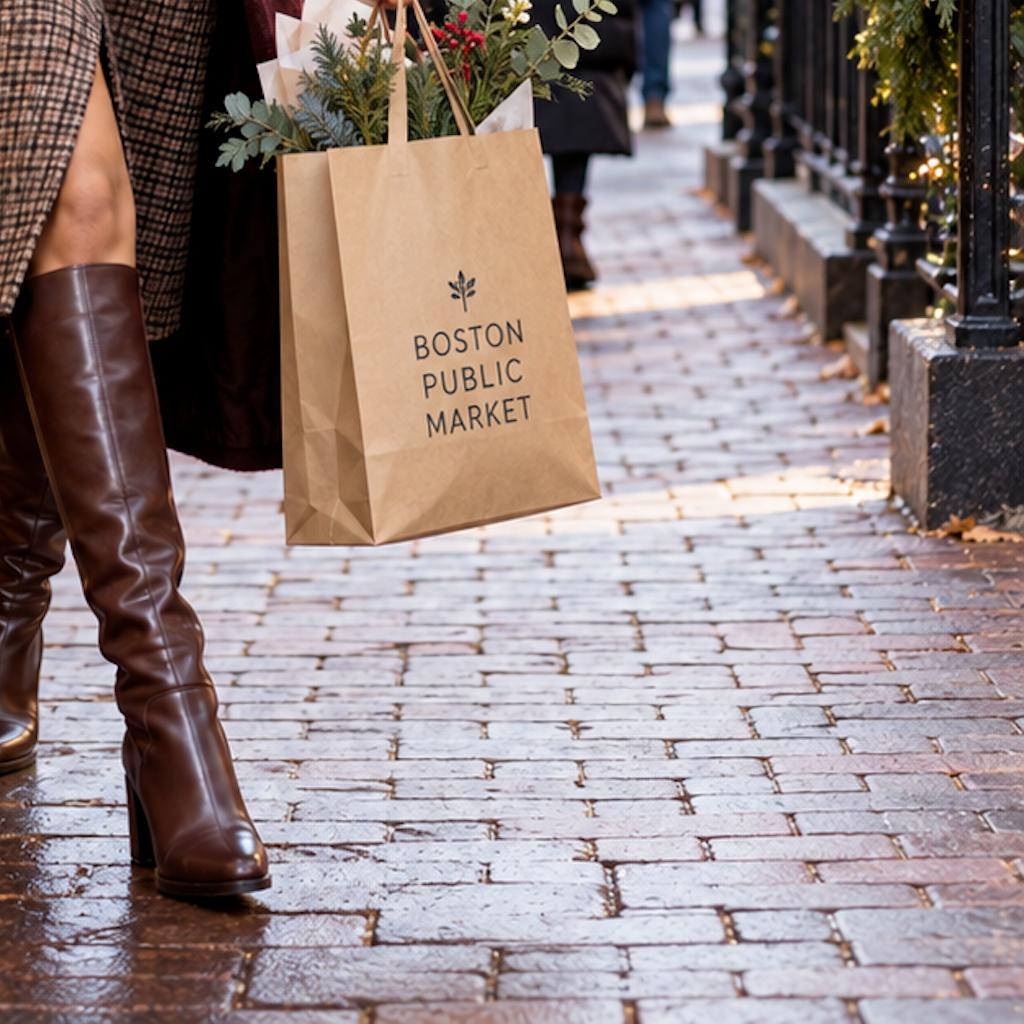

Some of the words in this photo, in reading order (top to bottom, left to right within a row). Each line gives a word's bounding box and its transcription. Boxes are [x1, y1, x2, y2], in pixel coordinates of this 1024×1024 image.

[414, 319, 524, 360] BOSTON
[422, 358, 523, 399] PUBLIC
[426, 395, 531, 438] MARKET
